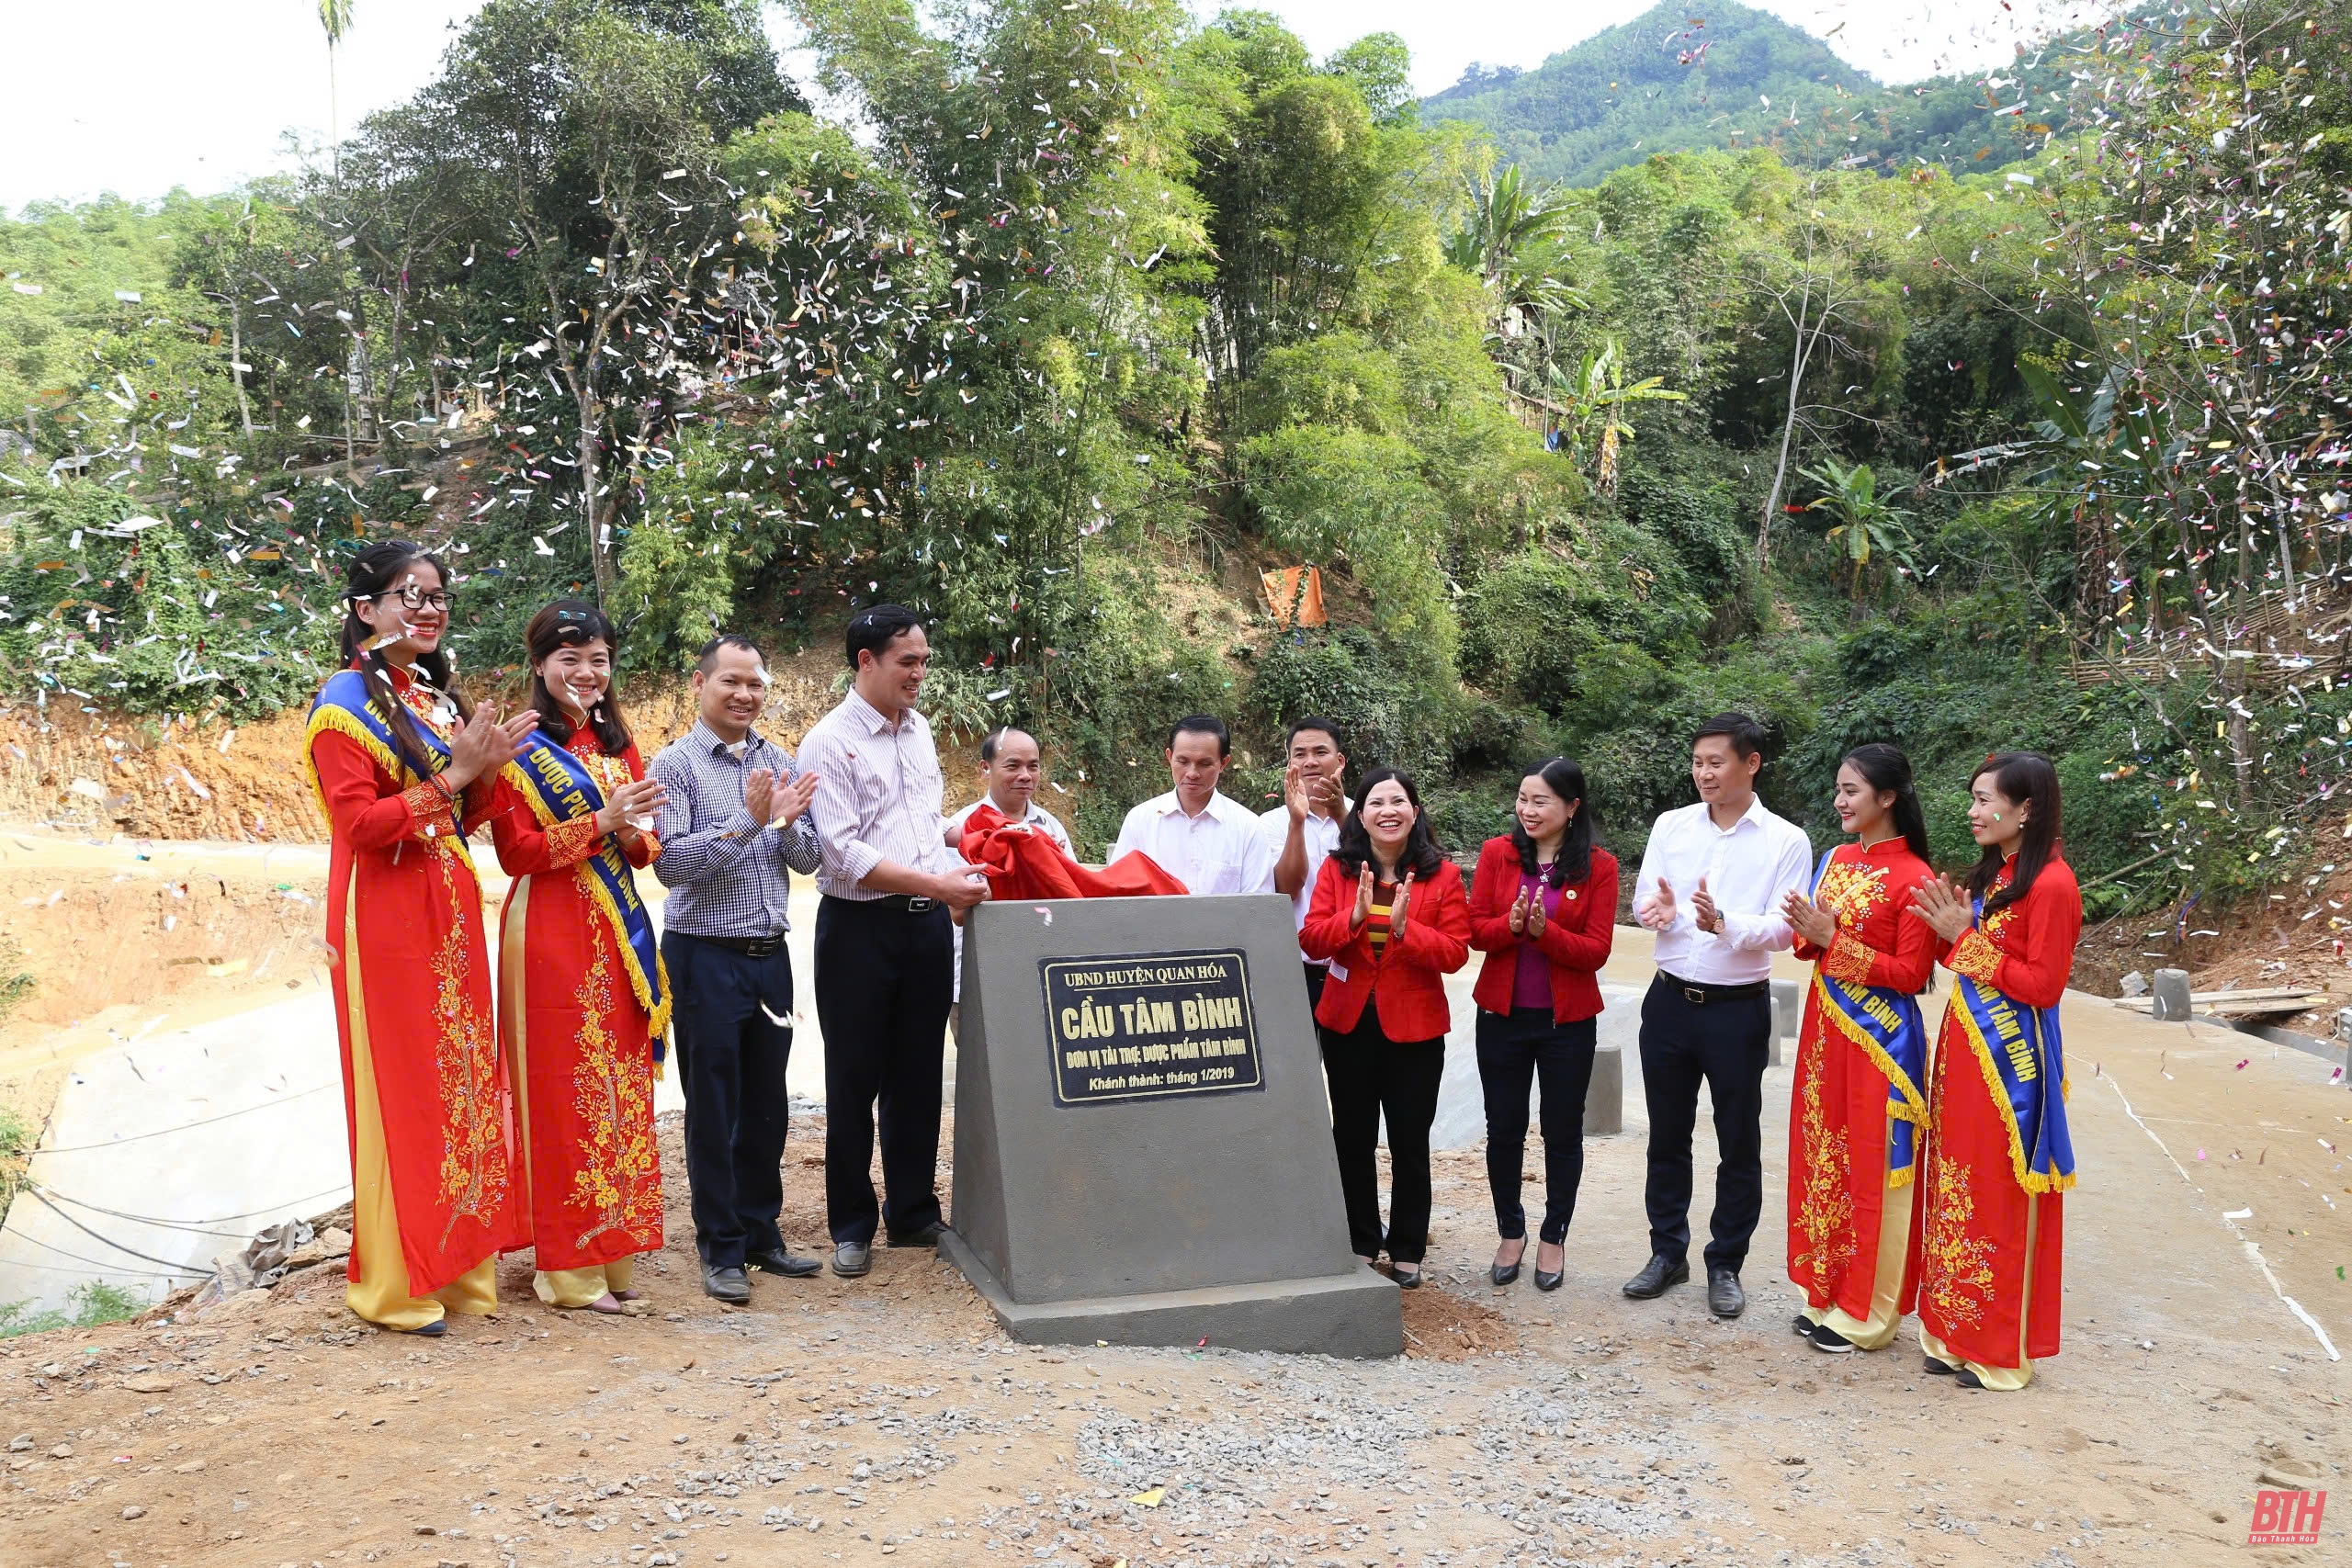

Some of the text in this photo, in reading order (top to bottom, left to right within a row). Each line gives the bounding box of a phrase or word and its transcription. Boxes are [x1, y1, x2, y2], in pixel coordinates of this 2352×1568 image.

[528, 746, 574, 795] DƯỢC
[1064, 962, 1227, 987] UBND HUYỆN QUAN HÓA
[1061, 993, 1243, 1040] CẦU TÂM BÌNH
[1861, 995, 1904, 1034] BÌNH
[1066, 1050, 1089, 1069] ĐƠN
[1088, 1049, 1102, 1070] VỊ
[1101, 1044, 1119, 1066] TÀI
[1200, 1037, 1223, 1058] TÂM
[1222, 1035, 1247, 1055] BÌNH
[1986, 999, 2022, 1041] TÂM
[2005, 1038, 2037, 1083] BÌNH
[1089, 1066, 1235, 1091] Khánh thành: tháng 1/2019
